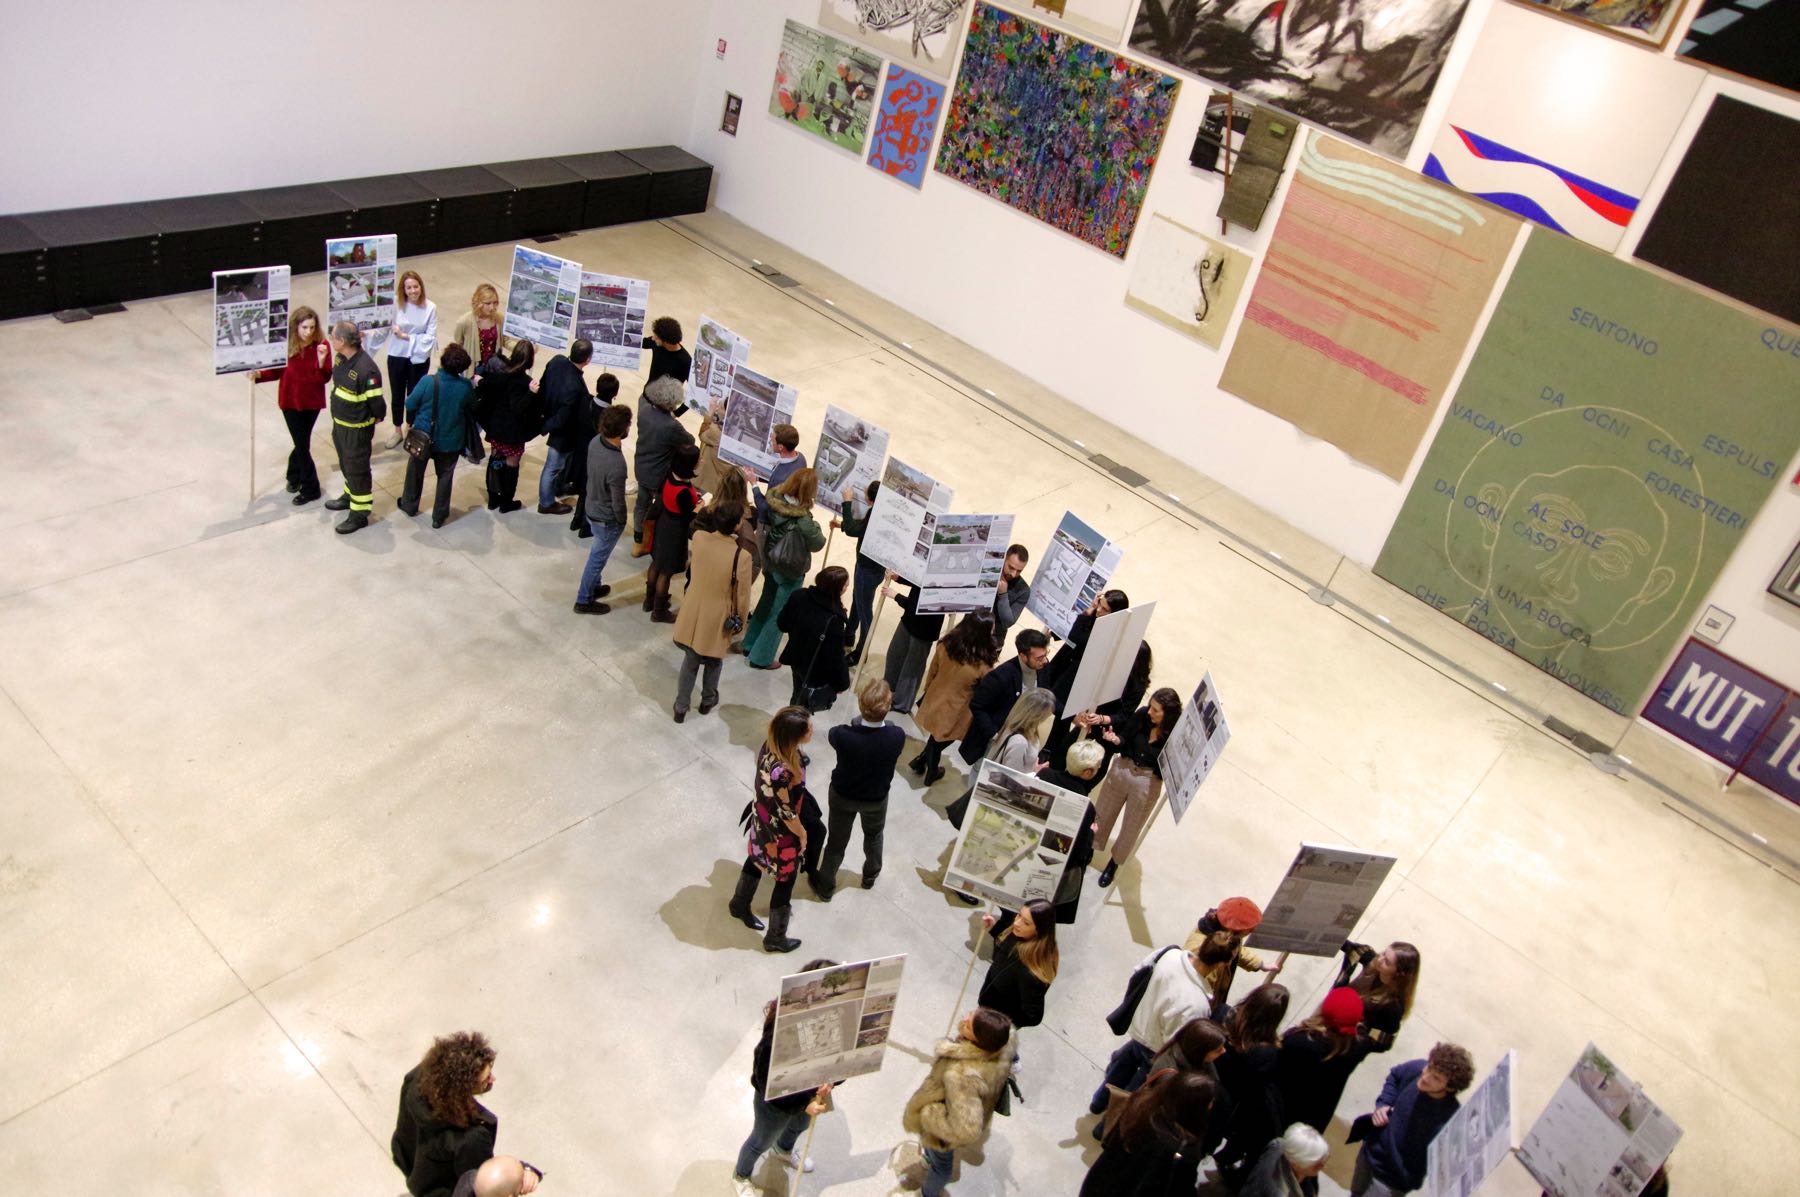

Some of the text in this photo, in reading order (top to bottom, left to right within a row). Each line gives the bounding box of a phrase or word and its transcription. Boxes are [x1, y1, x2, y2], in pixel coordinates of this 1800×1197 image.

[1569, 307, 1659, 357] SENTONO
[1450, 402, 1524, 447] VAGANO
[1540, 386, 1695, 471] DA OGNI CASA
[1702, 434, 1781, 480] ESPULSI
[1434, 479, 1457, 499] DA
[1512, 521, 1558, 552] CASO
[1527, 502, 1606, 551] AL SOLE
[1644, 471, 1748, 530] FORESTIERI
[1497, 585, 1593, 648] UNA BOCCA
[1415, 584, 1626, 712] CHE POSSA MUOVERSI
[1664, 661, 1766, 743] MUT
